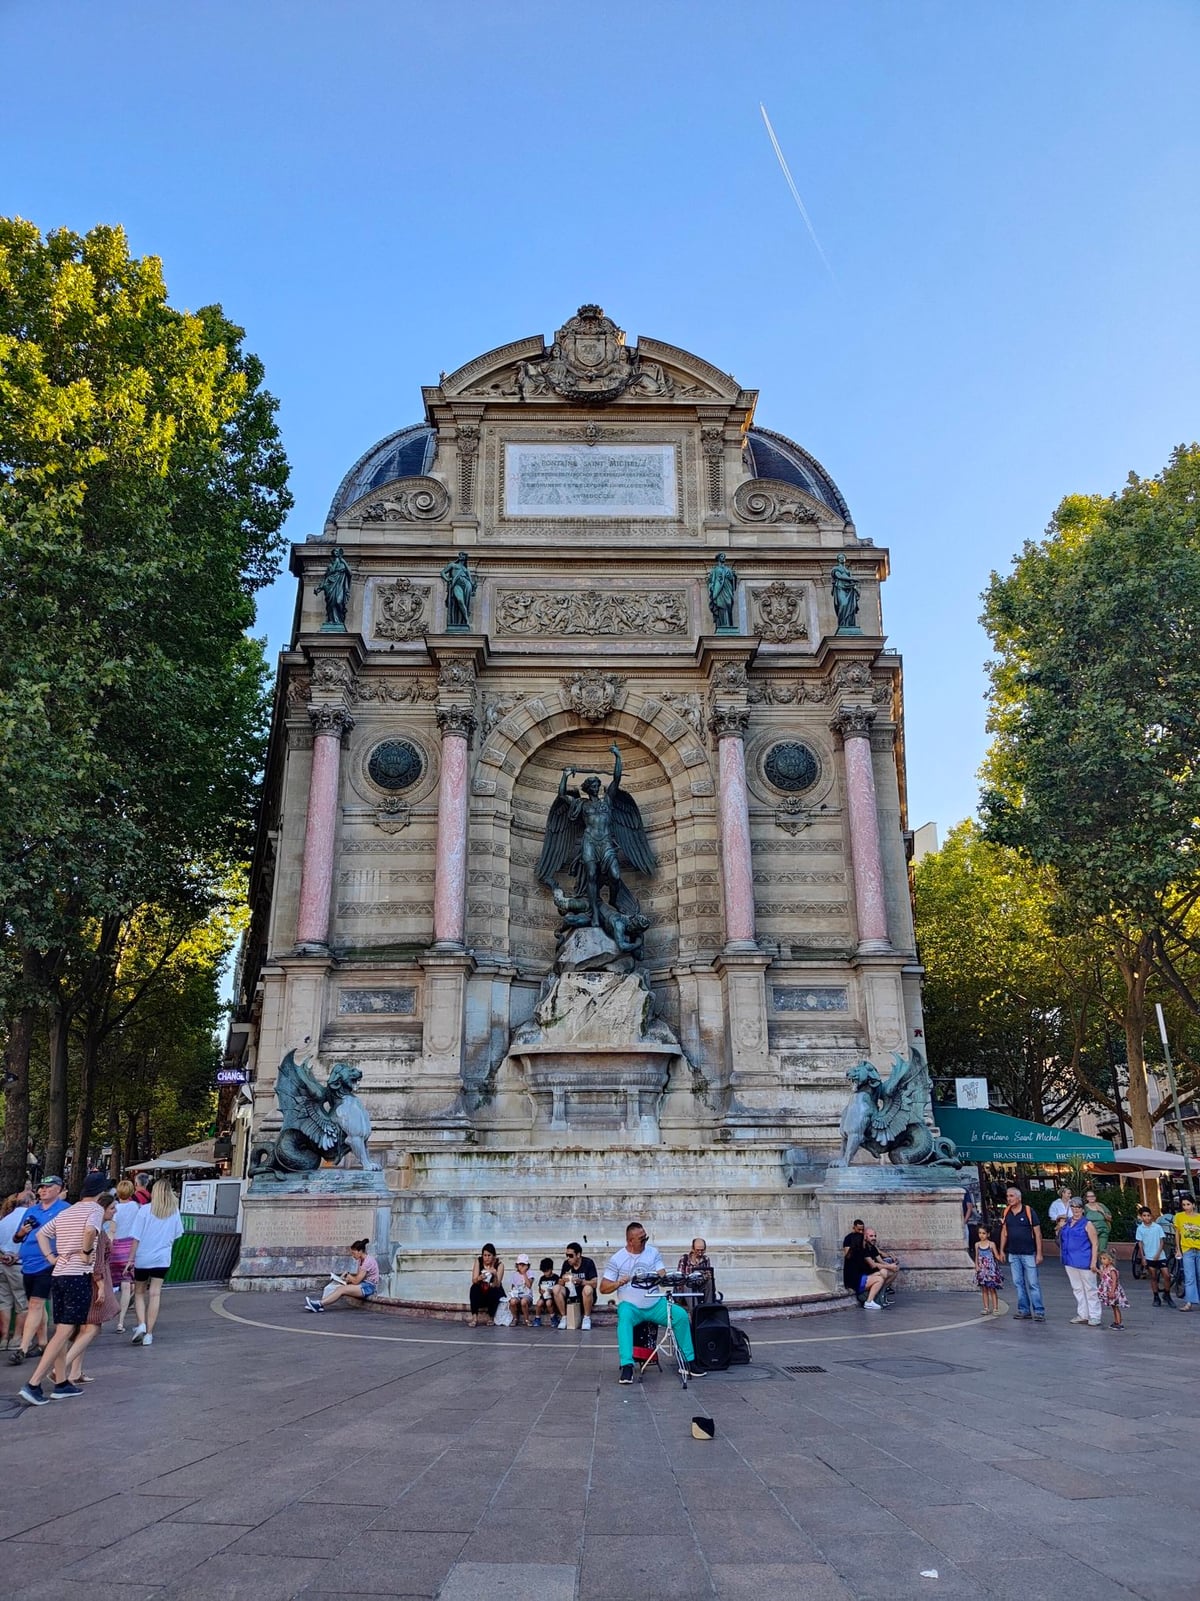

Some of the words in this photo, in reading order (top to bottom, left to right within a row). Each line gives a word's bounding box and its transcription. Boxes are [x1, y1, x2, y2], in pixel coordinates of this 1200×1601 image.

[1013, 1130, 1034, 1142] Saint
[1035, 1130, 1061, 1142] Michel
[993, 1152, 1034, 1160] BRASSERIE
